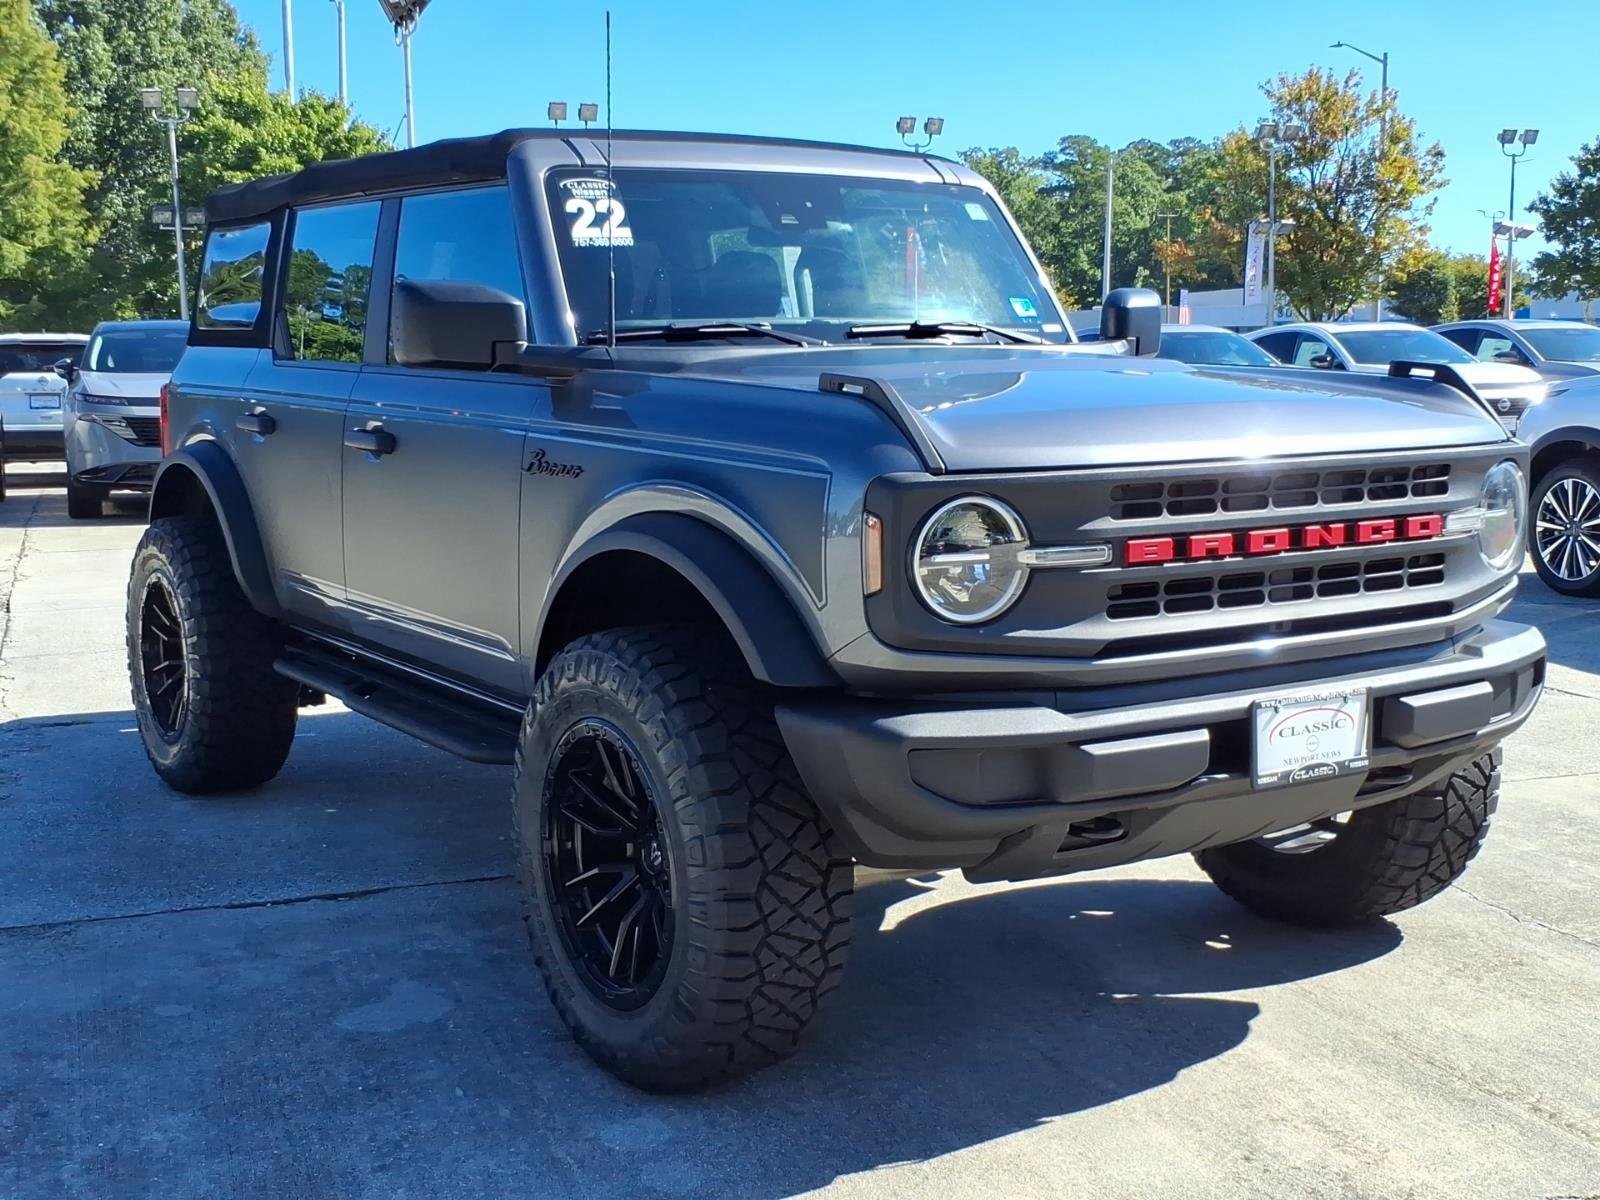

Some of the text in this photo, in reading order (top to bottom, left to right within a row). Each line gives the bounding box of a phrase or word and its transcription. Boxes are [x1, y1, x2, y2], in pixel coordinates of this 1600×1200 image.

[566, 181, 609, 190] CLASSIC
[565, 198, 633, 239] 22
[1248, 246, 1260, 297] NISSAN
[1125, 513, 1444, 564] BRONCO
[1278, 718, 1347, 738] CLASSIC
[1283, 749, 1342, 767] NEWPORT NEWS
[1294, 766, 1334, 780] CLASSIC
